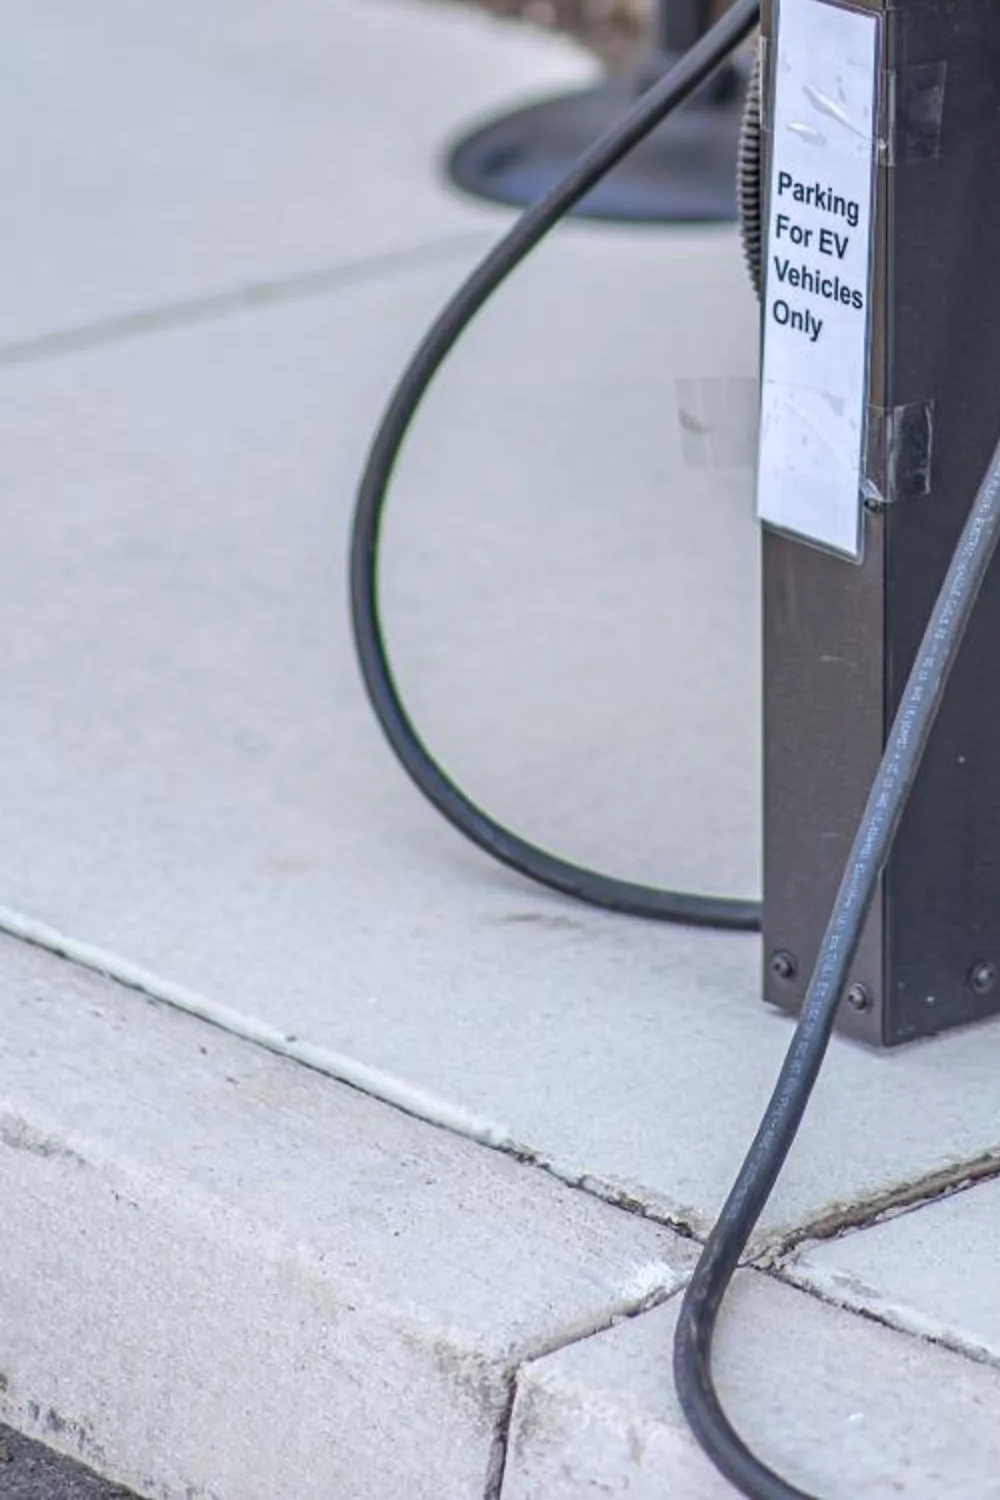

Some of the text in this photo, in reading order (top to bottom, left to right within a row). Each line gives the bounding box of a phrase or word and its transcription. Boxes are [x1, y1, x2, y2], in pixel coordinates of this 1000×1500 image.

[778, 171, 859, 227] Parking
[776, 214, 849, 260] For EV
[774, 256, 864, 310] Vehicles
[773, 300, 823, 342] Only
